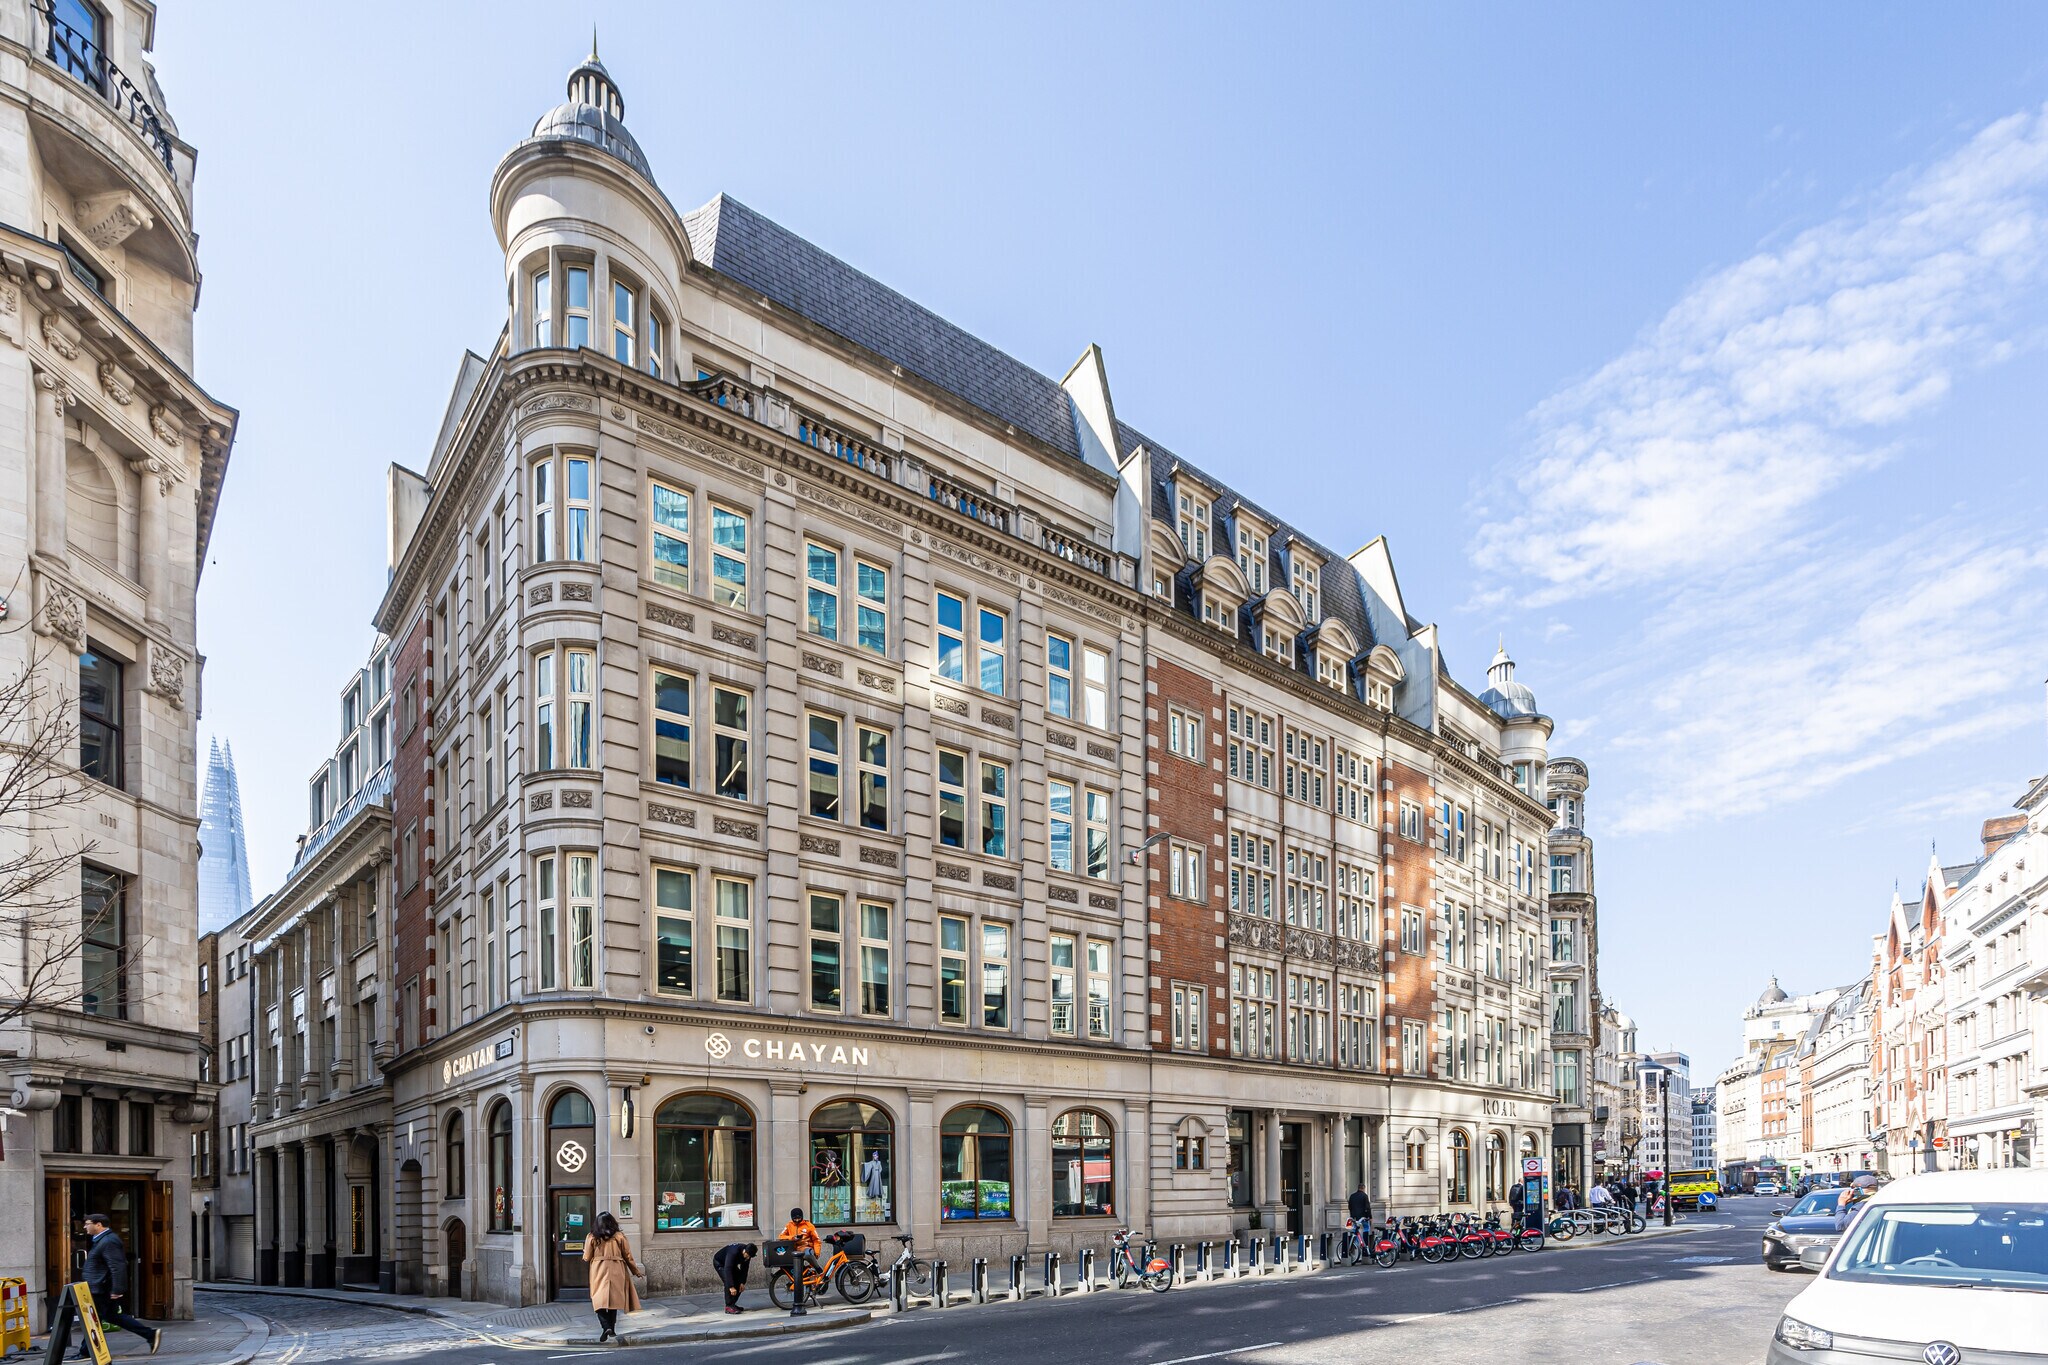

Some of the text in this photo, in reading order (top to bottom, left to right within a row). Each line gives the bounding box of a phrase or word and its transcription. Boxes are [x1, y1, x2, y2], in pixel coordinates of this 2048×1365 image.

[453, 1044, 494, 1078] CHAYAN
[743, 1039, 869, 1066] CHAYAN
[1483, 1099, 1517, 1117] ROAR
[354, 1211, 362, 1221] 2
